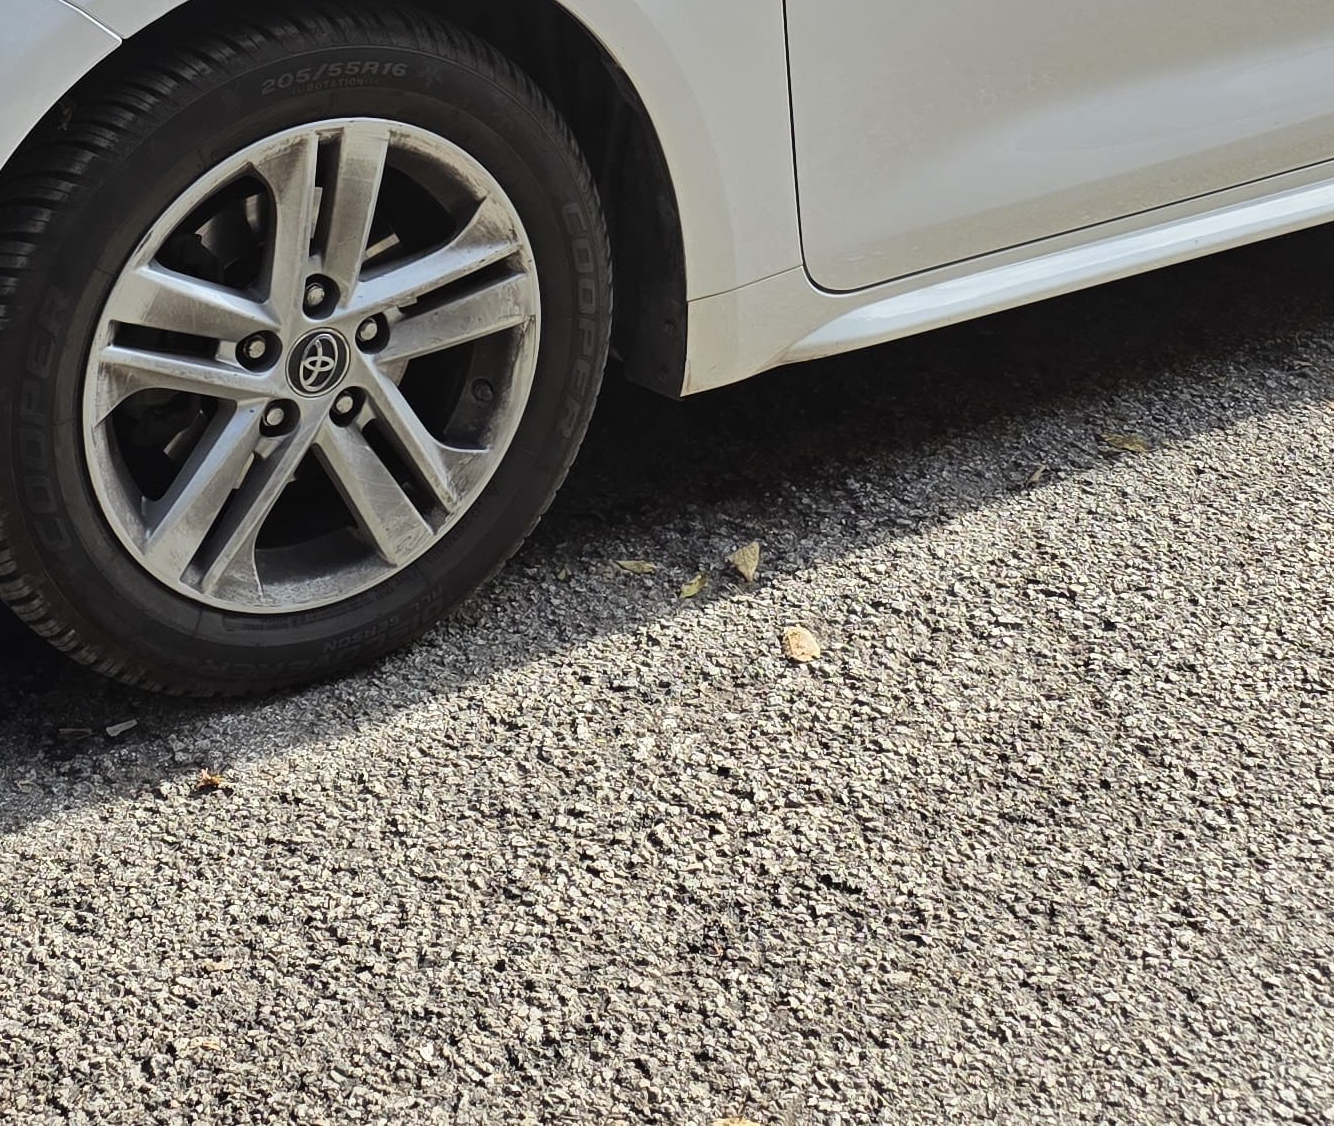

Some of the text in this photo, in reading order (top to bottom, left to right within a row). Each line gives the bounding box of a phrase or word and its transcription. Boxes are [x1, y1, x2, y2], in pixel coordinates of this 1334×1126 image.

[261, 60, 408, 96] 205/55R16
[19, 284, 73, 552] COOPER
[557, 202, 596, 438] COOPER
